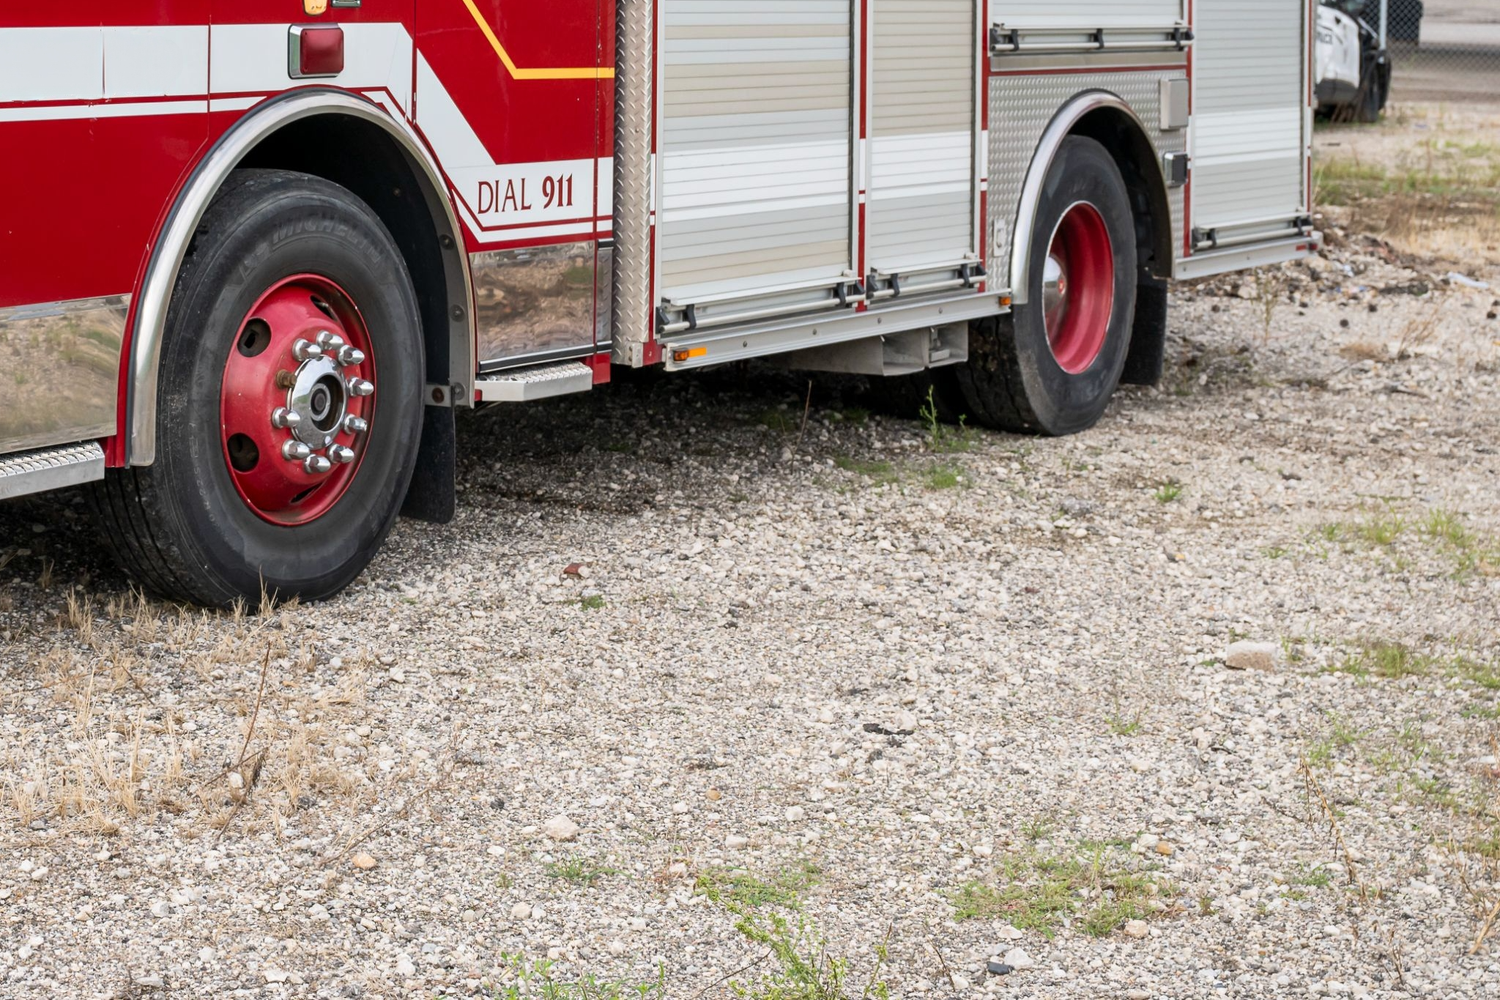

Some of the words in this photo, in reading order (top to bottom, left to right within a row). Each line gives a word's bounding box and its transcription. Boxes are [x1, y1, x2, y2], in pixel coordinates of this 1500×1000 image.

[477, 177, 532, 215] DIAL
[541, 173, 573, 210] 911
[272, 216, 383, 263] MICHELIN
